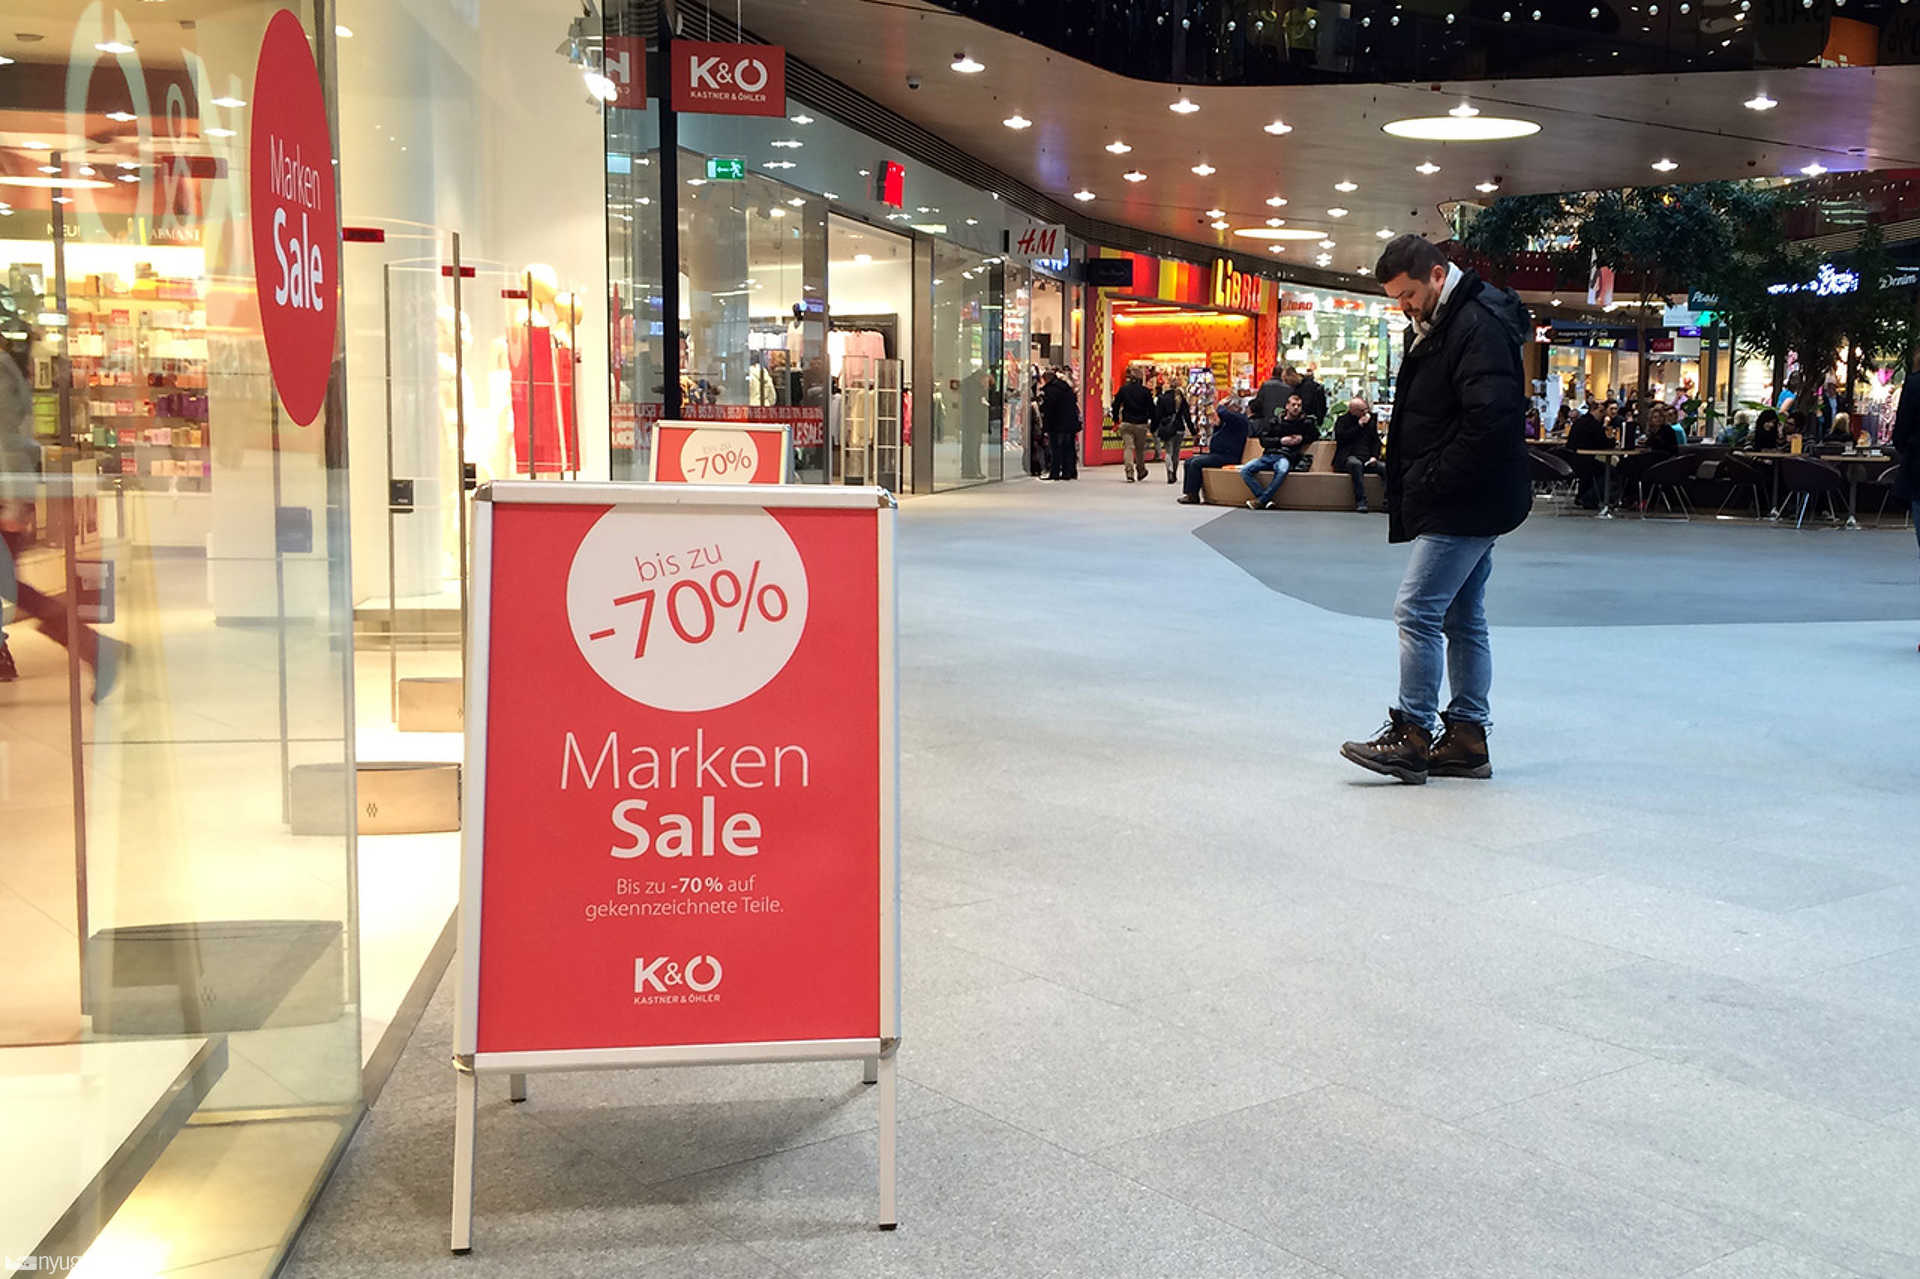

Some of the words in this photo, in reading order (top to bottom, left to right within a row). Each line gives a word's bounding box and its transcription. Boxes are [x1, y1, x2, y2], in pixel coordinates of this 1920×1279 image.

[690, 91, 730, 100] KASTNER
[270, 134, 322, 211] Marken
[273, 207, 324, 312] Sale
[687, 448, 752, 480] -70%
[634, 552, 681, 582] bis
[687, 544, 722, 570] zu
[589, 560, 789, 660] -70%
[560, 728, 809, 790] Marken
[610, 796, 762, 859] Sale
[616, 878, 640, 895] Bis
[645, 881, 666, 894] zu
[727, 874, 757, 893] auf
[585, 900, 738, 922] gekennzeichnete
[741, 896, 785, 914] Teile.
[633, 995, 680, 1005] KASTNER
